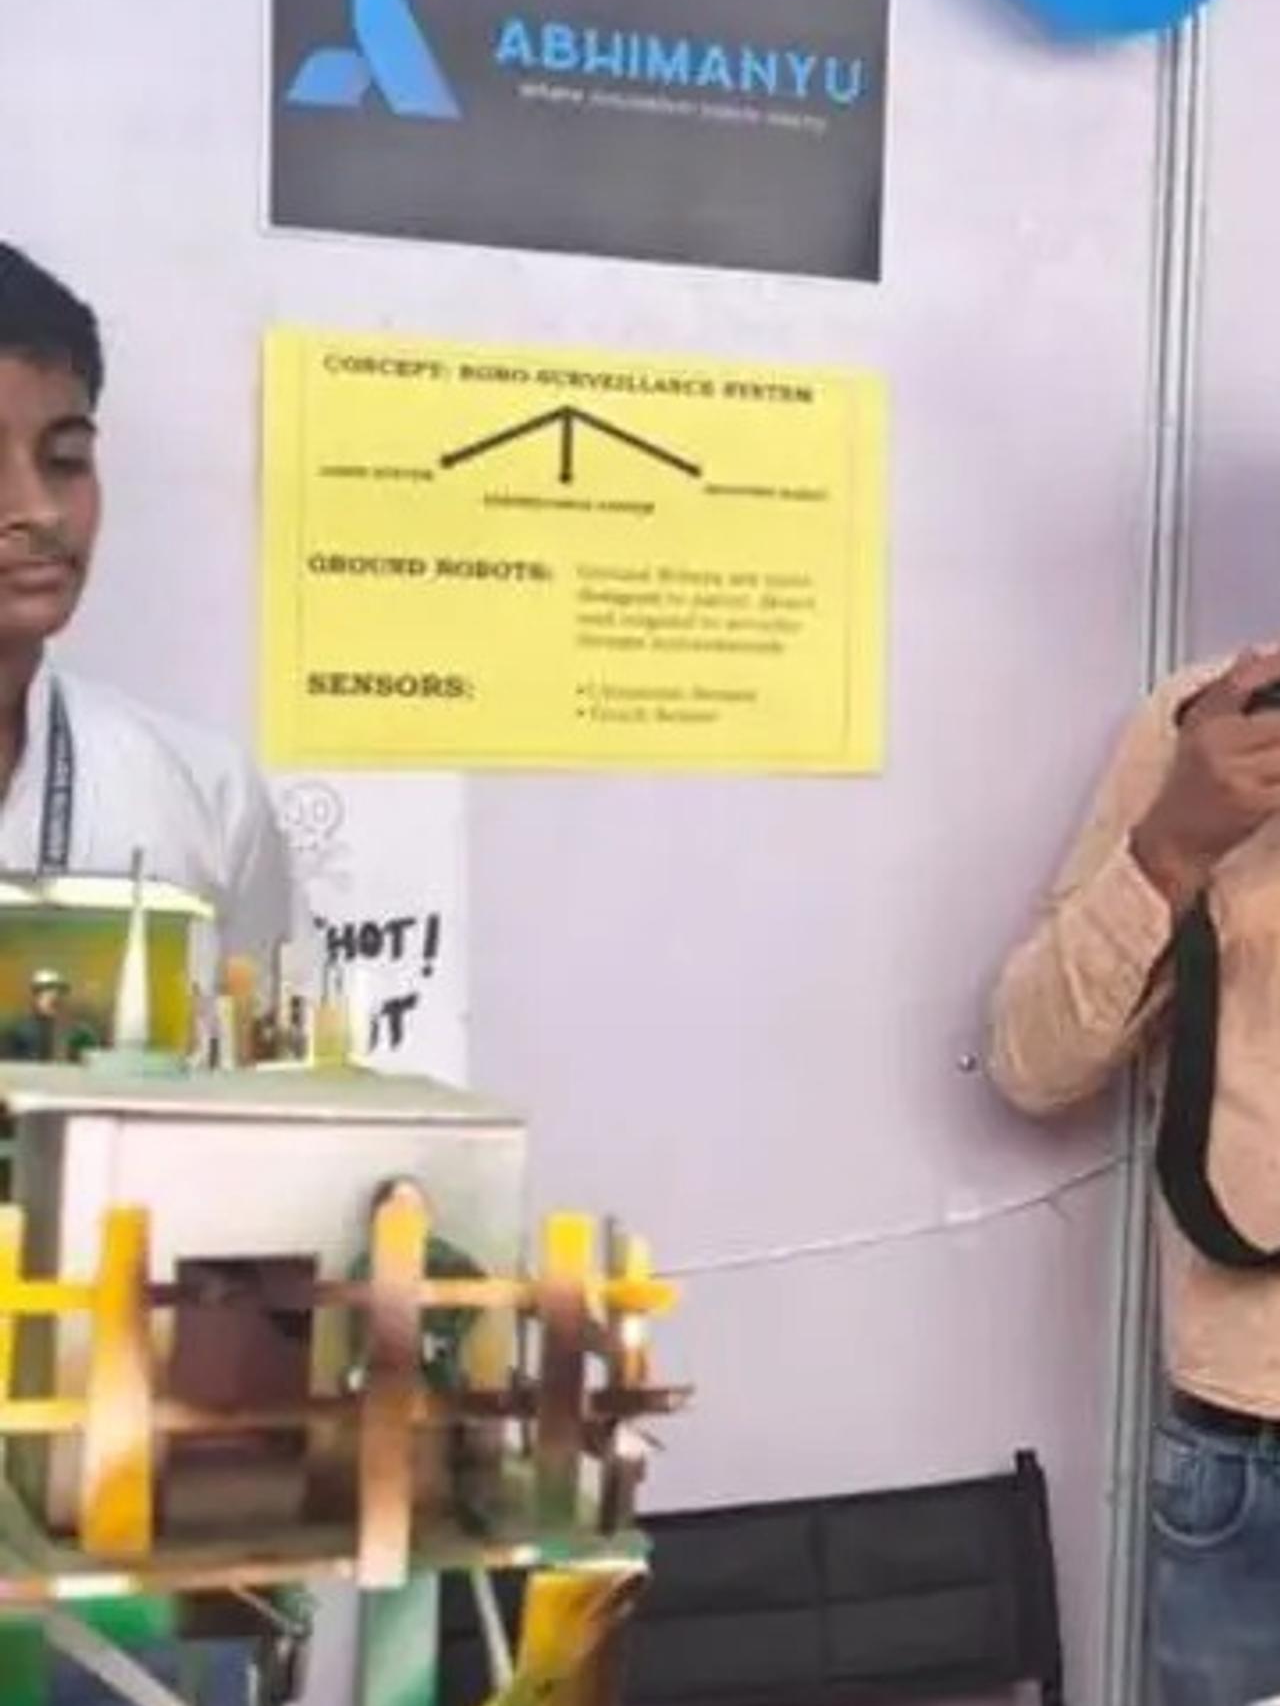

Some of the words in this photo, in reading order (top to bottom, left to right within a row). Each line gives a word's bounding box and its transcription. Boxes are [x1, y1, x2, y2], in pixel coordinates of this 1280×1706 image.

[495, 18, 864, 104] ABHIMANYU
[307, 553, 427, 577] GROUND
[436, 557, 553, 582] ROBOTS:
[307, 672, 475, 699] SENSORS:
